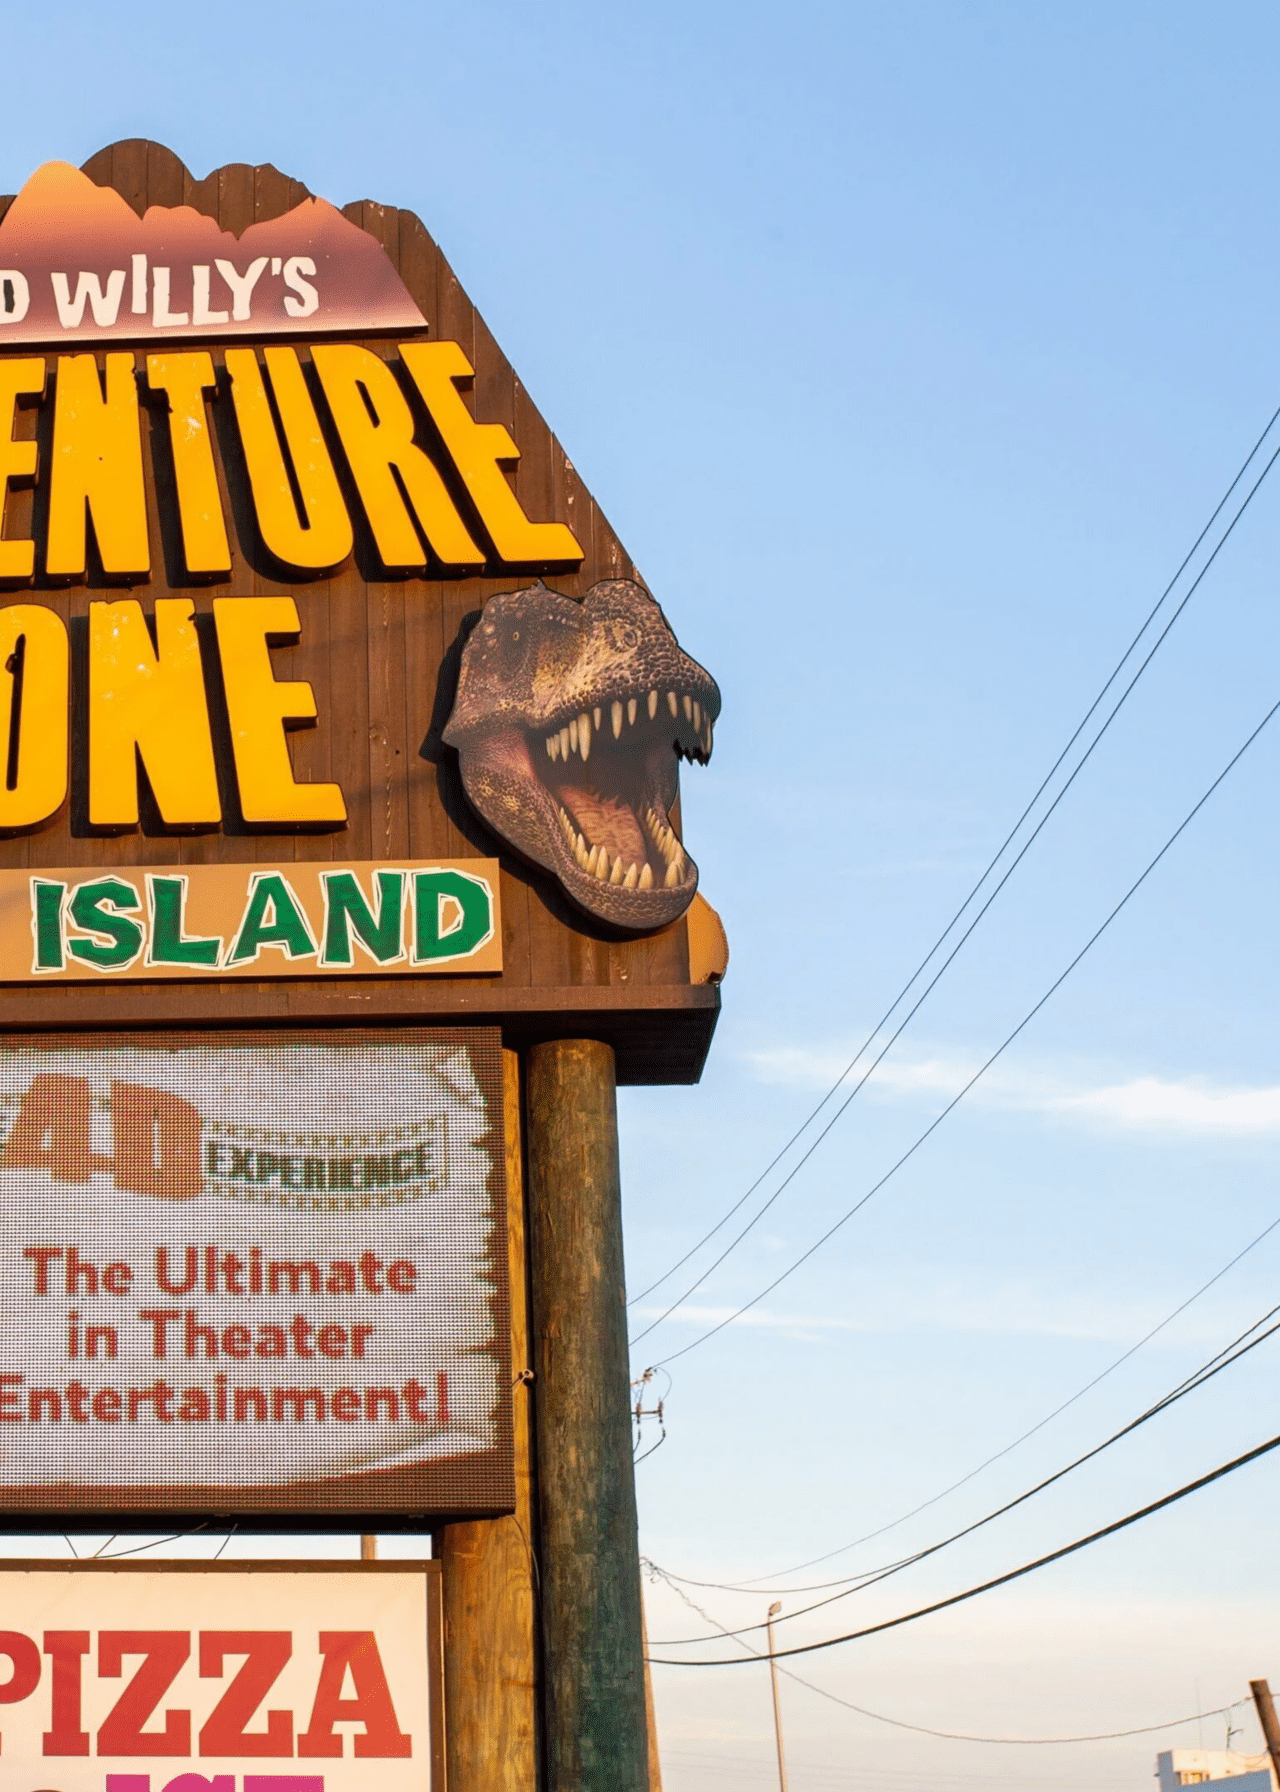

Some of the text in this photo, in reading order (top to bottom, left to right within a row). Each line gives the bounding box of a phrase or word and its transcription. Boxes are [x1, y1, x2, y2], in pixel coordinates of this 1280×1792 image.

[51, 253, 320, 329] WILLY'S
[29, 867, 497, 976] ISLAND
[205, 1138, 432, 1193] EXPERIENCE
[23, 1246, 418, 1297] The Ultimate
[67, 1309, 375, 1361] in Theater
